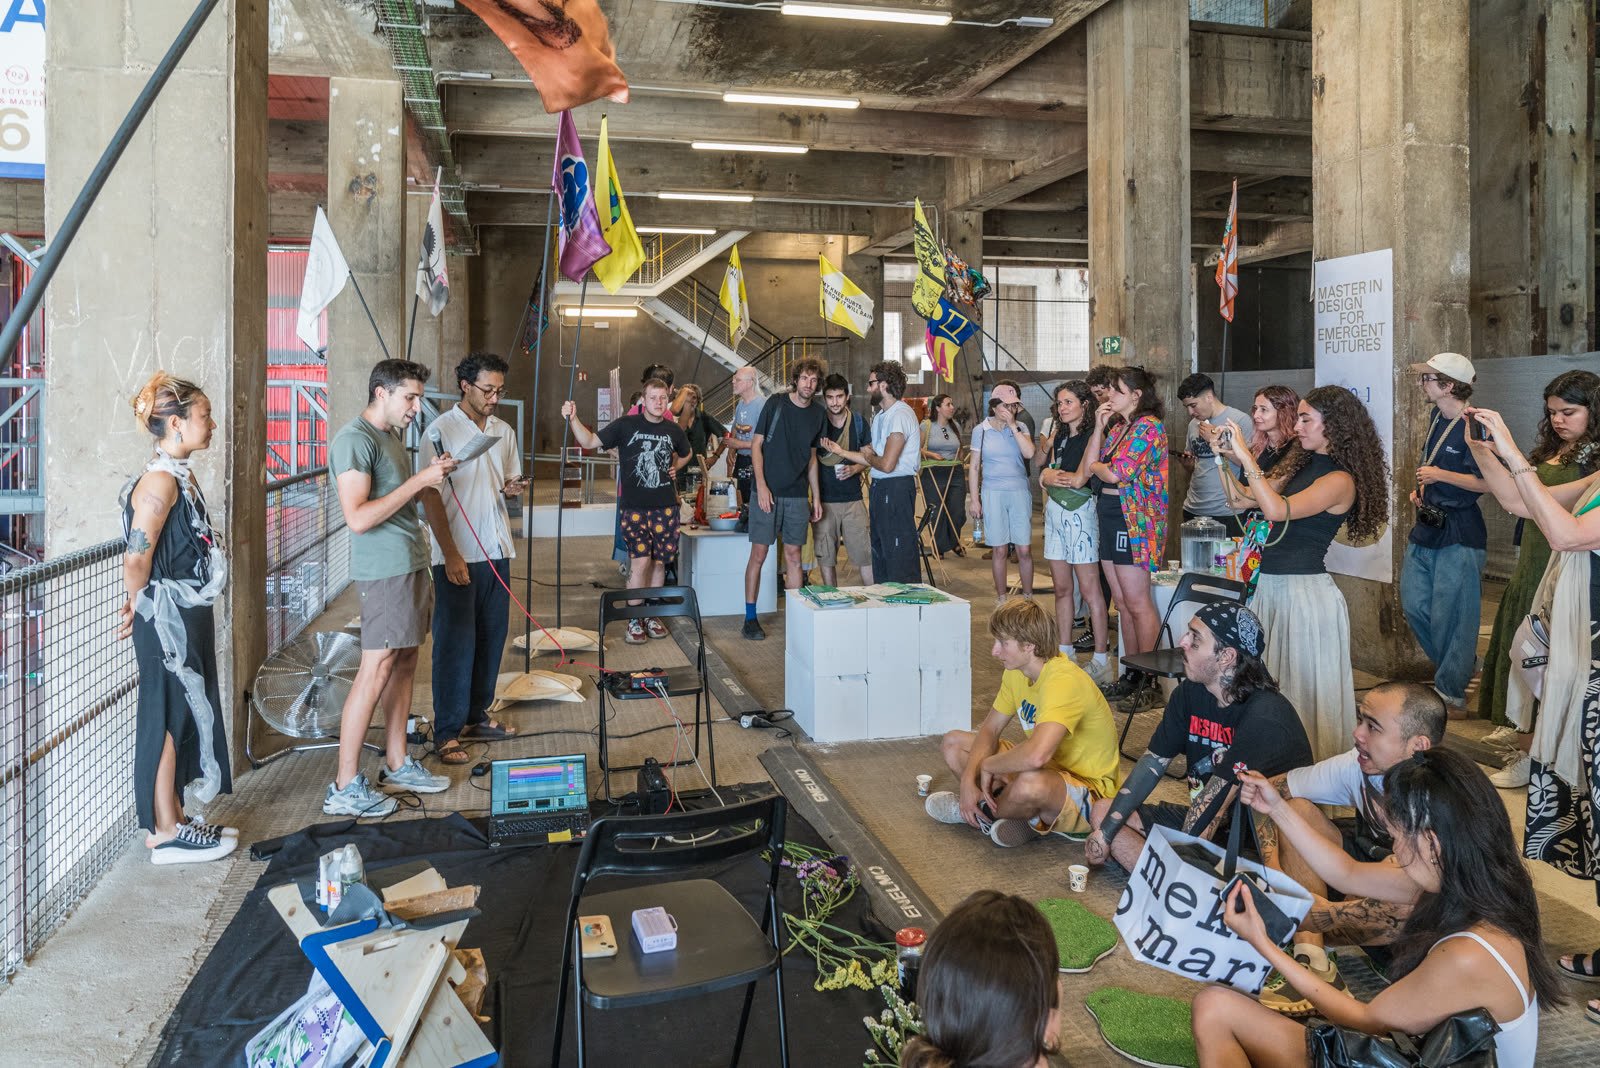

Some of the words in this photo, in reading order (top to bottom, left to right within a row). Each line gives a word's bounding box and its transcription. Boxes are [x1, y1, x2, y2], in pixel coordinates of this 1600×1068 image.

[0, 107, 31, 152] 6
[1318, 281, 1366, 300] MASTER
[1369, 278, 1383, 294] IN
[1317, 296, 1363, 314] DESIGN
[1339, 310, 1365, 325] FOR
[1318, 322, 1386, 341] EMERGENT
[1325, 337, 1382, 354] FUTURES
[867, 865, 922, 919] ENELMO
